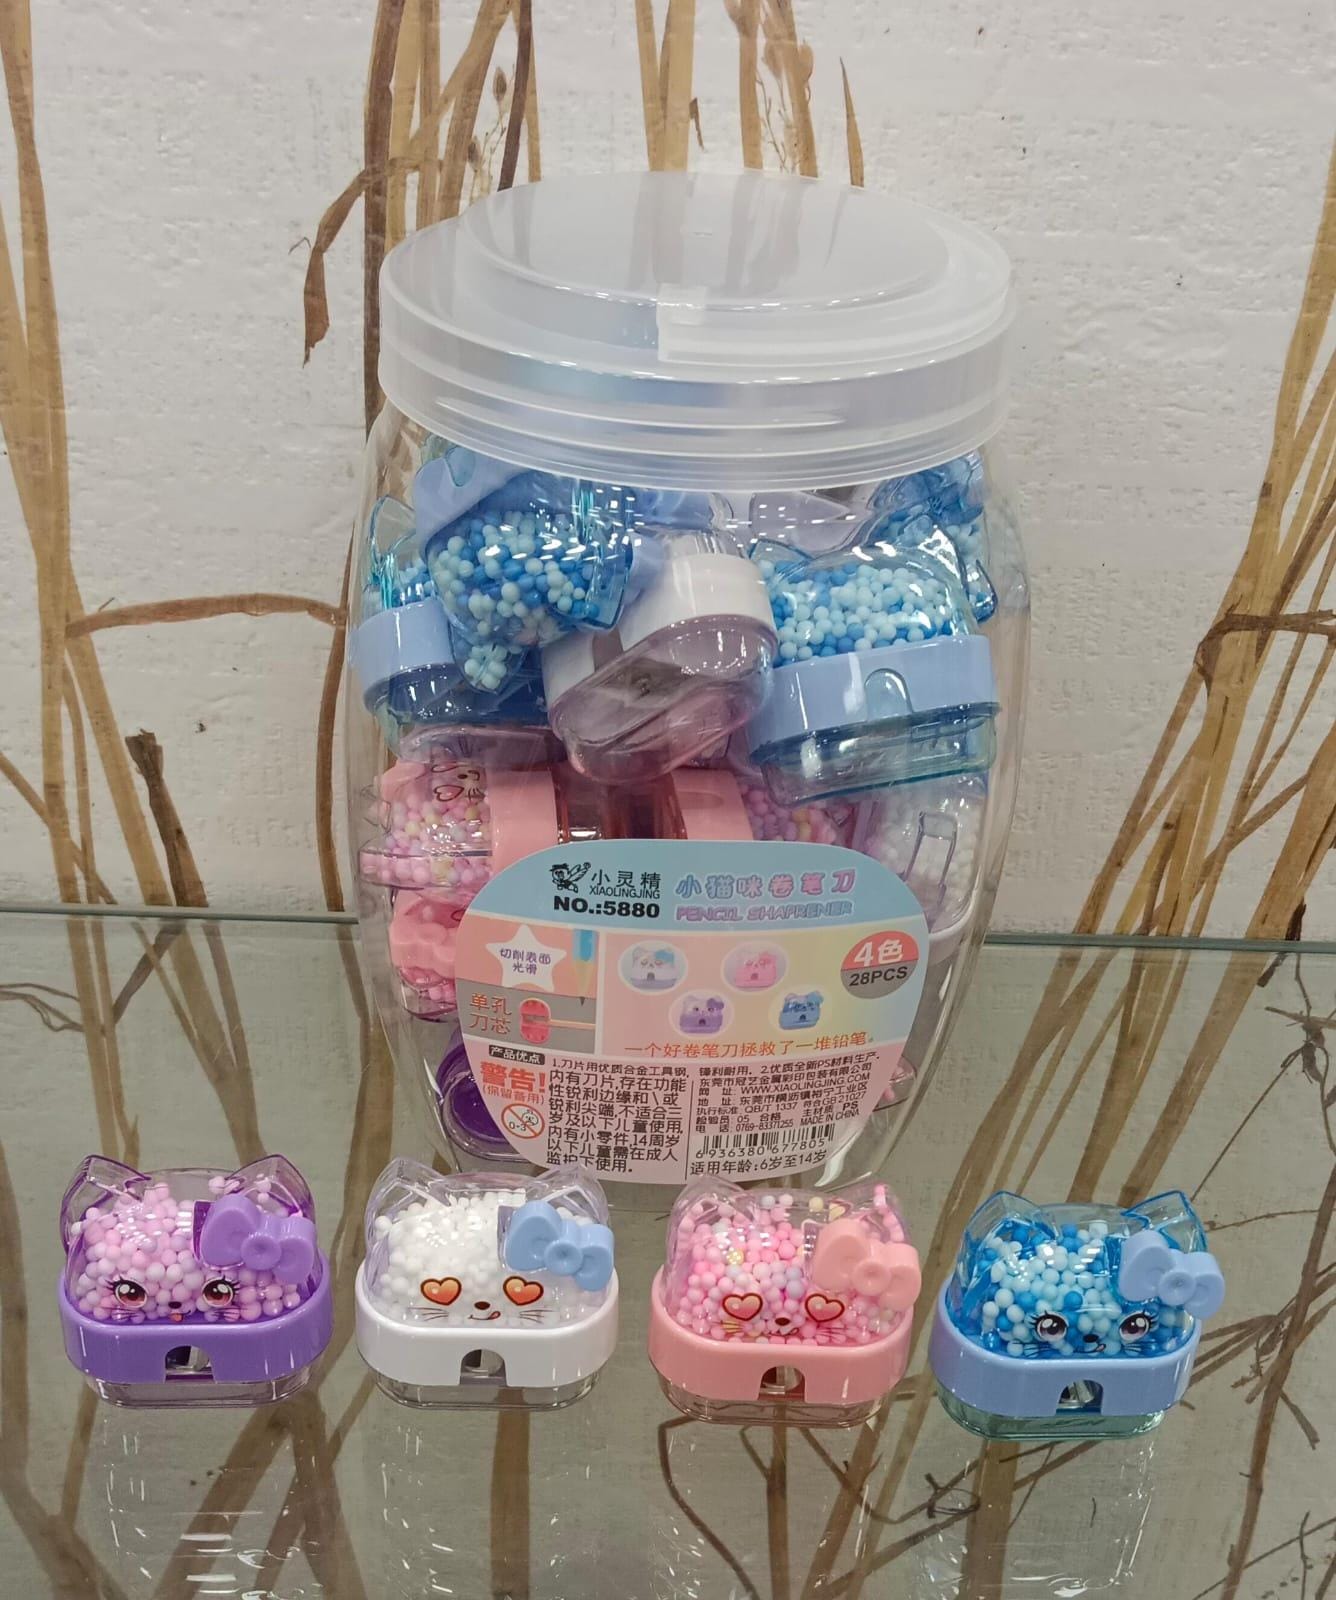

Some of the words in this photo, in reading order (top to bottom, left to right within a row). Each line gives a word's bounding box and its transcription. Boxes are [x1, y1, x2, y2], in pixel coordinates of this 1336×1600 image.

[591, 870, 661, 890] 小灵精
[675, 868, 856, 899] 小猫咪卷笔刀
[590, 885, 660, 899] XIAOLINGJING
[553, 896, 660, 918] NO.:5880
[675, 905, 743, 922] PENCIL
[500, 948, 551, 965] 切削表面
[853, 938, 904, 967] 4色
[512, 963, 537, 975] 光滑
[849, 966, 908, 987] 28PCS
[470, 992, 512, 1016] 单孔
[469, 1013, 511, 1035] 刀芯
[490, 1046, 541, 1064] 产品优点
[741, 1073, 870, 1094] WWW.XIAOLINGJINGCOM
[760, 1113, 781, 1121] 合格
[843, 1101, 858, 1111] PS
[776, 1102, 797, 1111] 1337
[800, 1115, 824, 1126] MADE
[836, 1109, 859, 1120] CHINA
[548, 1138, 678, 1161] 以下儿童需在成人
[690, 1150, 826, 1176] 适用年龄:6岁至14岁
